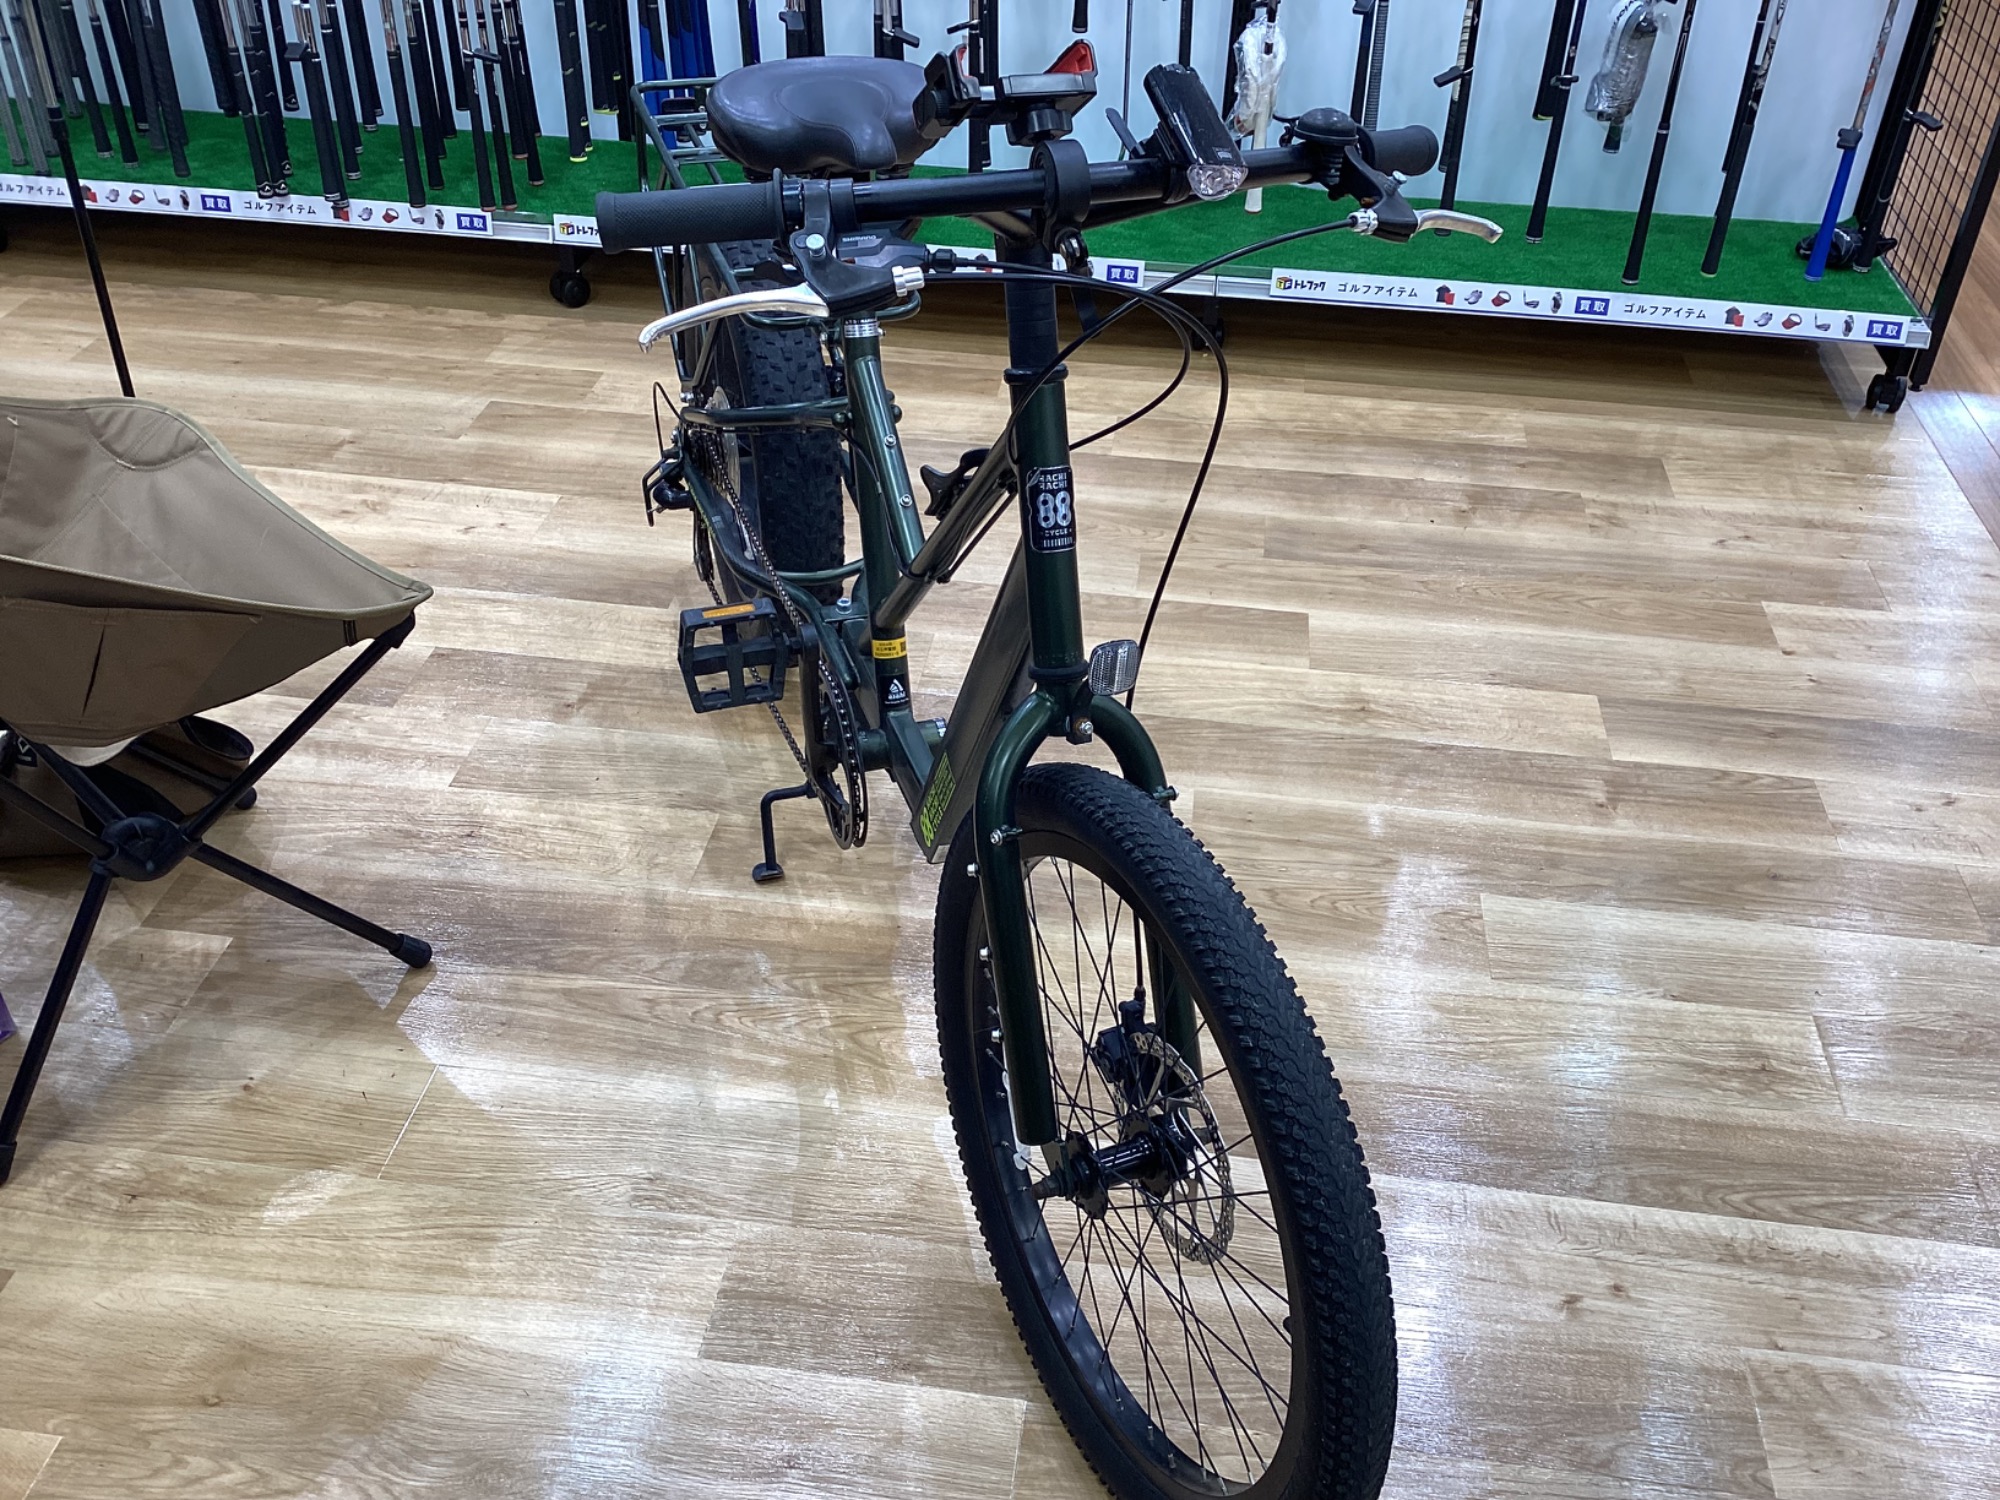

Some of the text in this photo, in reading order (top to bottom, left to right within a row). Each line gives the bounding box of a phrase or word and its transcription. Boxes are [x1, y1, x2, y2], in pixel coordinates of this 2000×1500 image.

[243, 200, 317, 215] ゴルフアイテム
[459, 216, 485, 229] 買取
[1110, 267, 1136, 280] 買取
[1293, 279, 1327, 291] トレファク
[1337, 282, 1418, 298] ゴルフアイテム
[1578, 300, 1606, 312] 買取
[1623, 302, 1707, 319] ゴルフアイテム
[1036, 490, 1072, 528] 88
